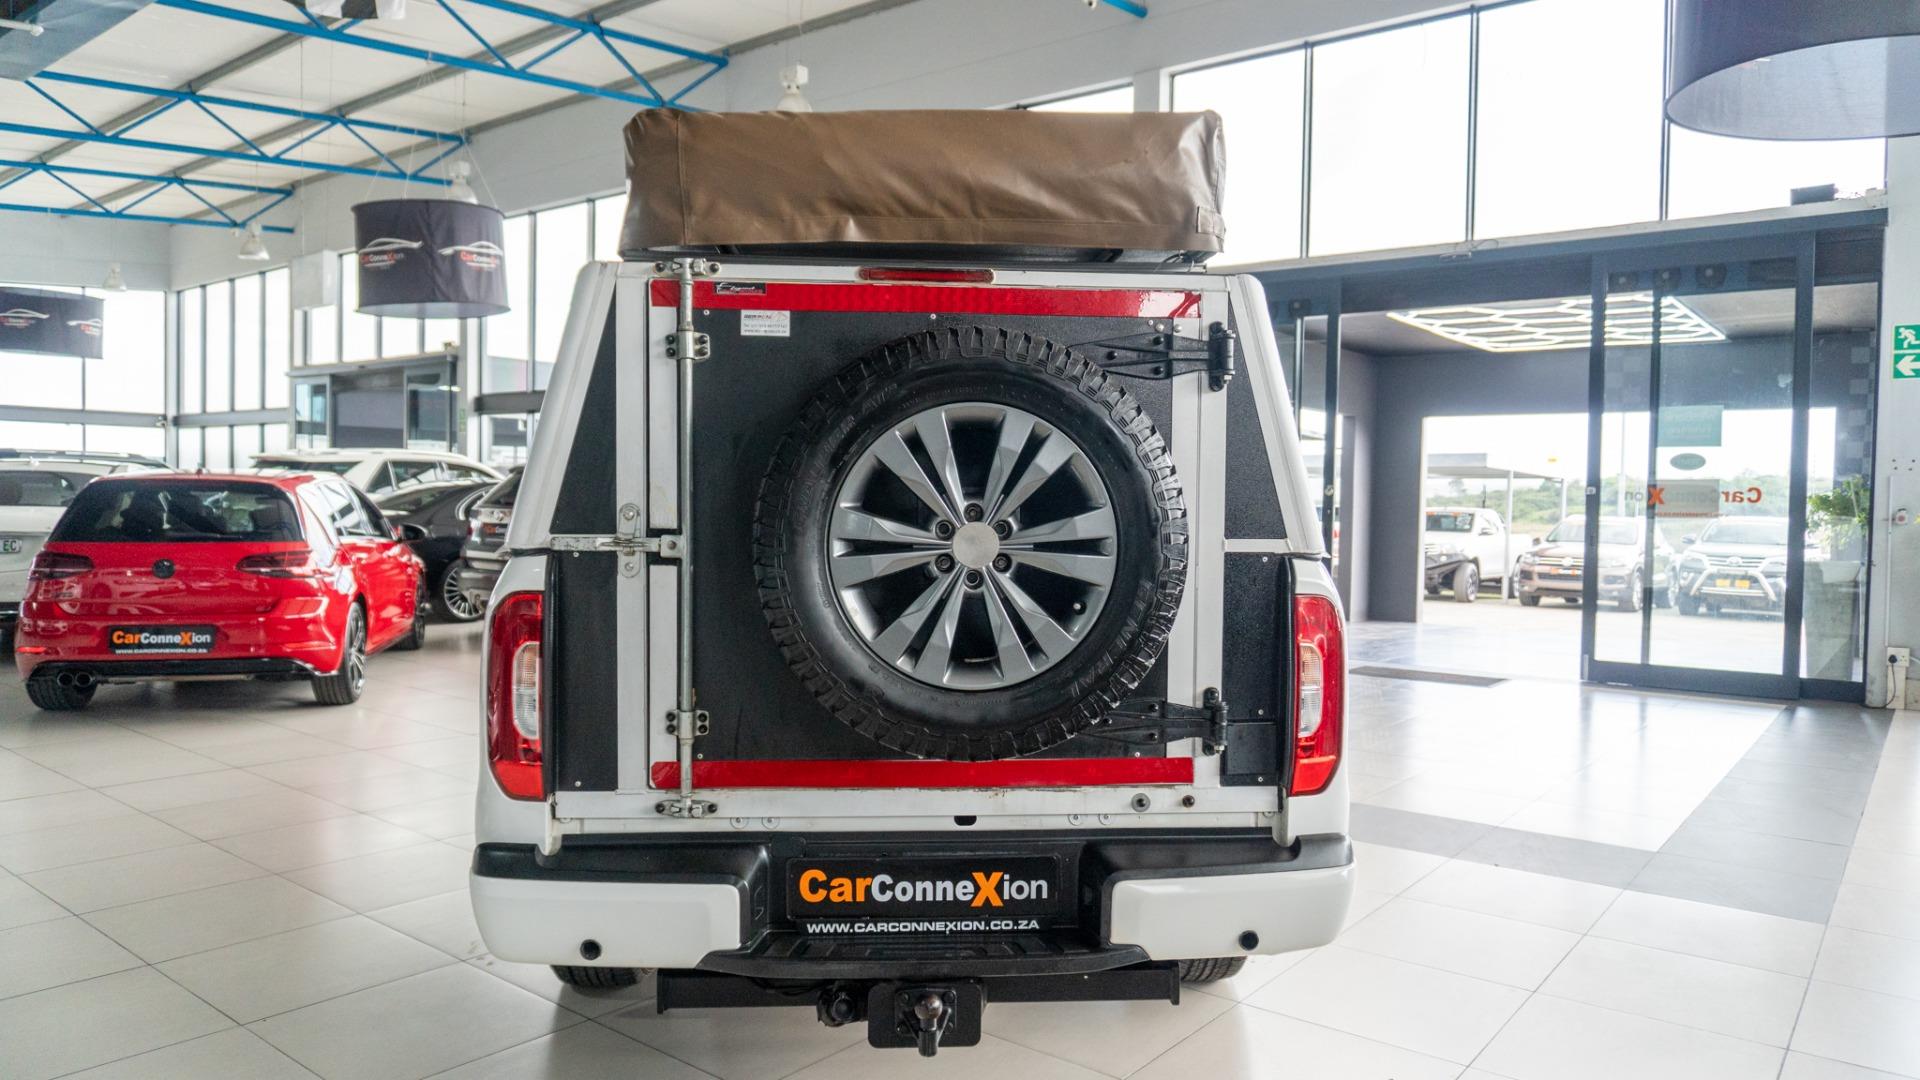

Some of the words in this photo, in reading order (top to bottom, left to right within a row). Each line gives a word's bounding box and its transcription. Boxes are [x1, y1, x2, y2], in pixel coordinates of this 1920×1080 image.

[112, 630, 211, 645] CarConneXion
[799, 869, 1048, 908] CarConneXion
[807, 920, 1040, 934] WWW.CARCONNEXION.CO.ZA
